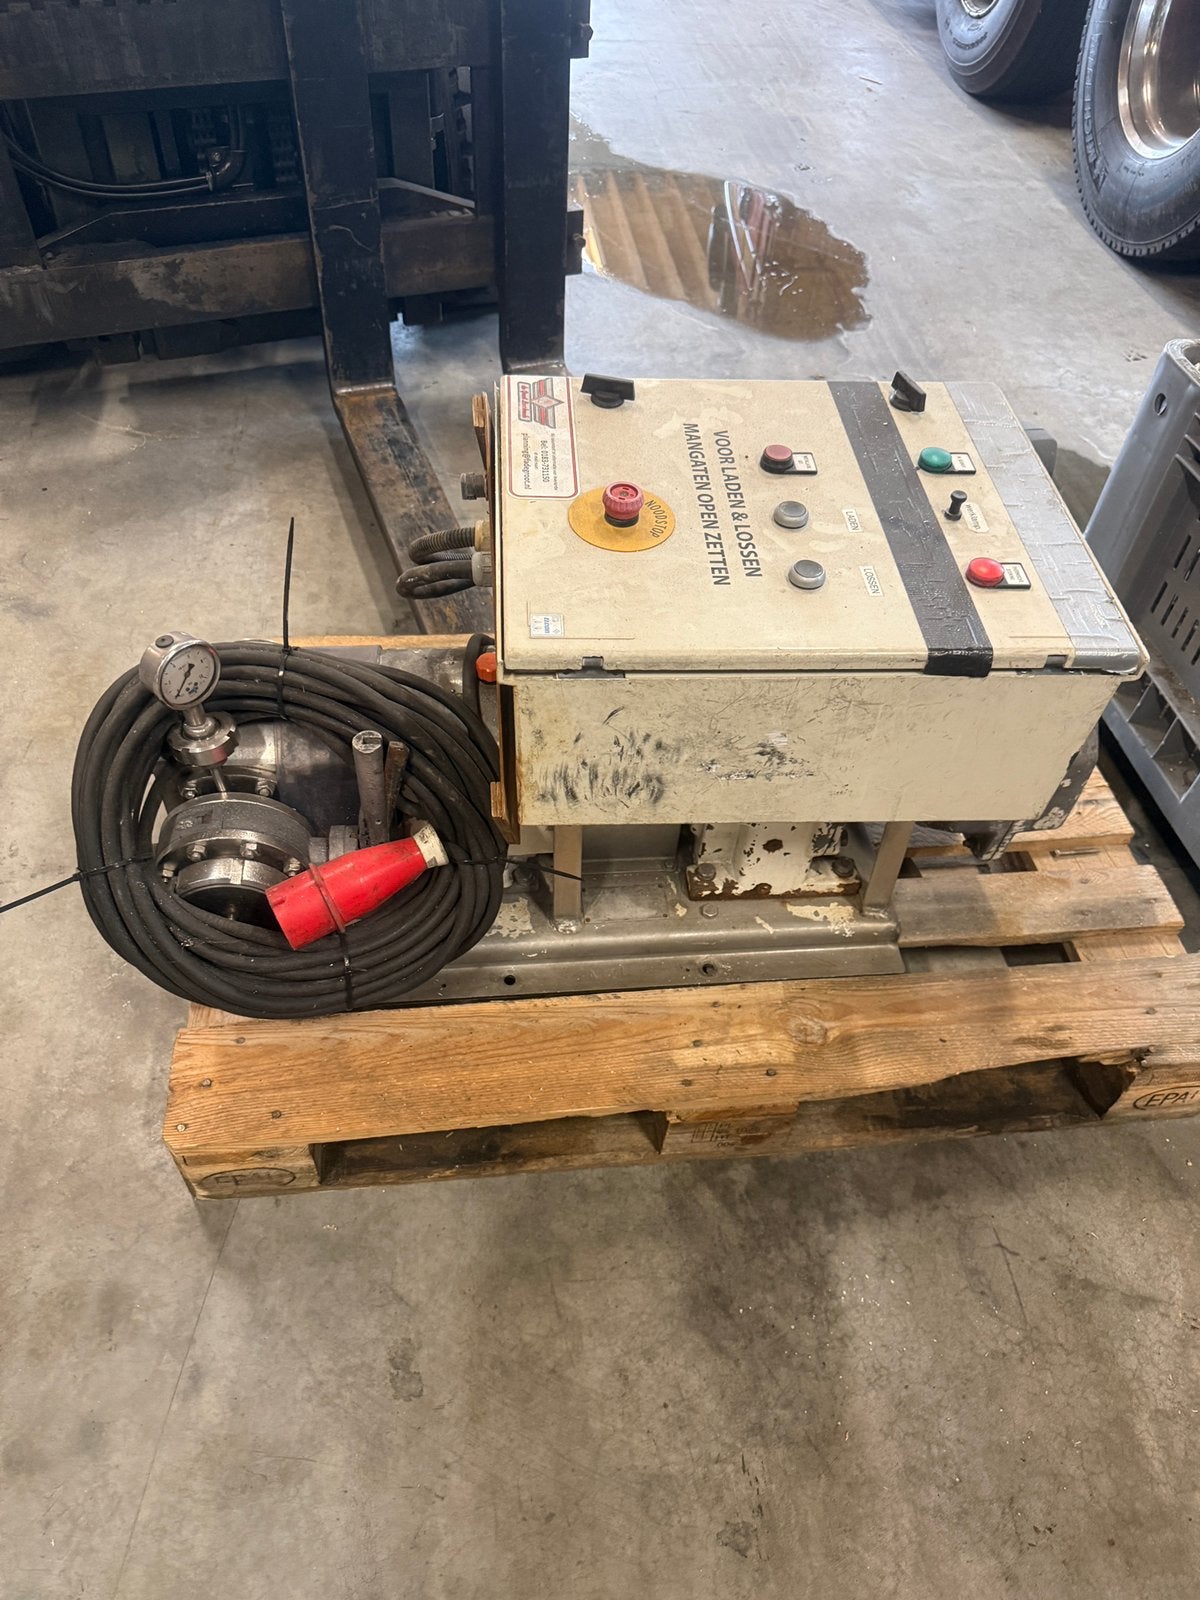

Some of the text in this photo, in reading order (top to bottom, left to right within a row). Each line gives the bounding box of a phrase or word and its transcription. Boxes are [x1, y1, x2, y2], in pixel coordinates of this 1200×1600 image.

[541, 450, 550, 483] 0183-731150
[645, 499, 665, 539] NOODSTOP
[683, 423, 731, 585] MANGATEN OPEN ZETTEN
[713, 430, 763, 577] VOOR LADEN & LOSSEN
[846, 511, 859, 531] LADEN
[863, 568, 880, 594] LOSSEN
